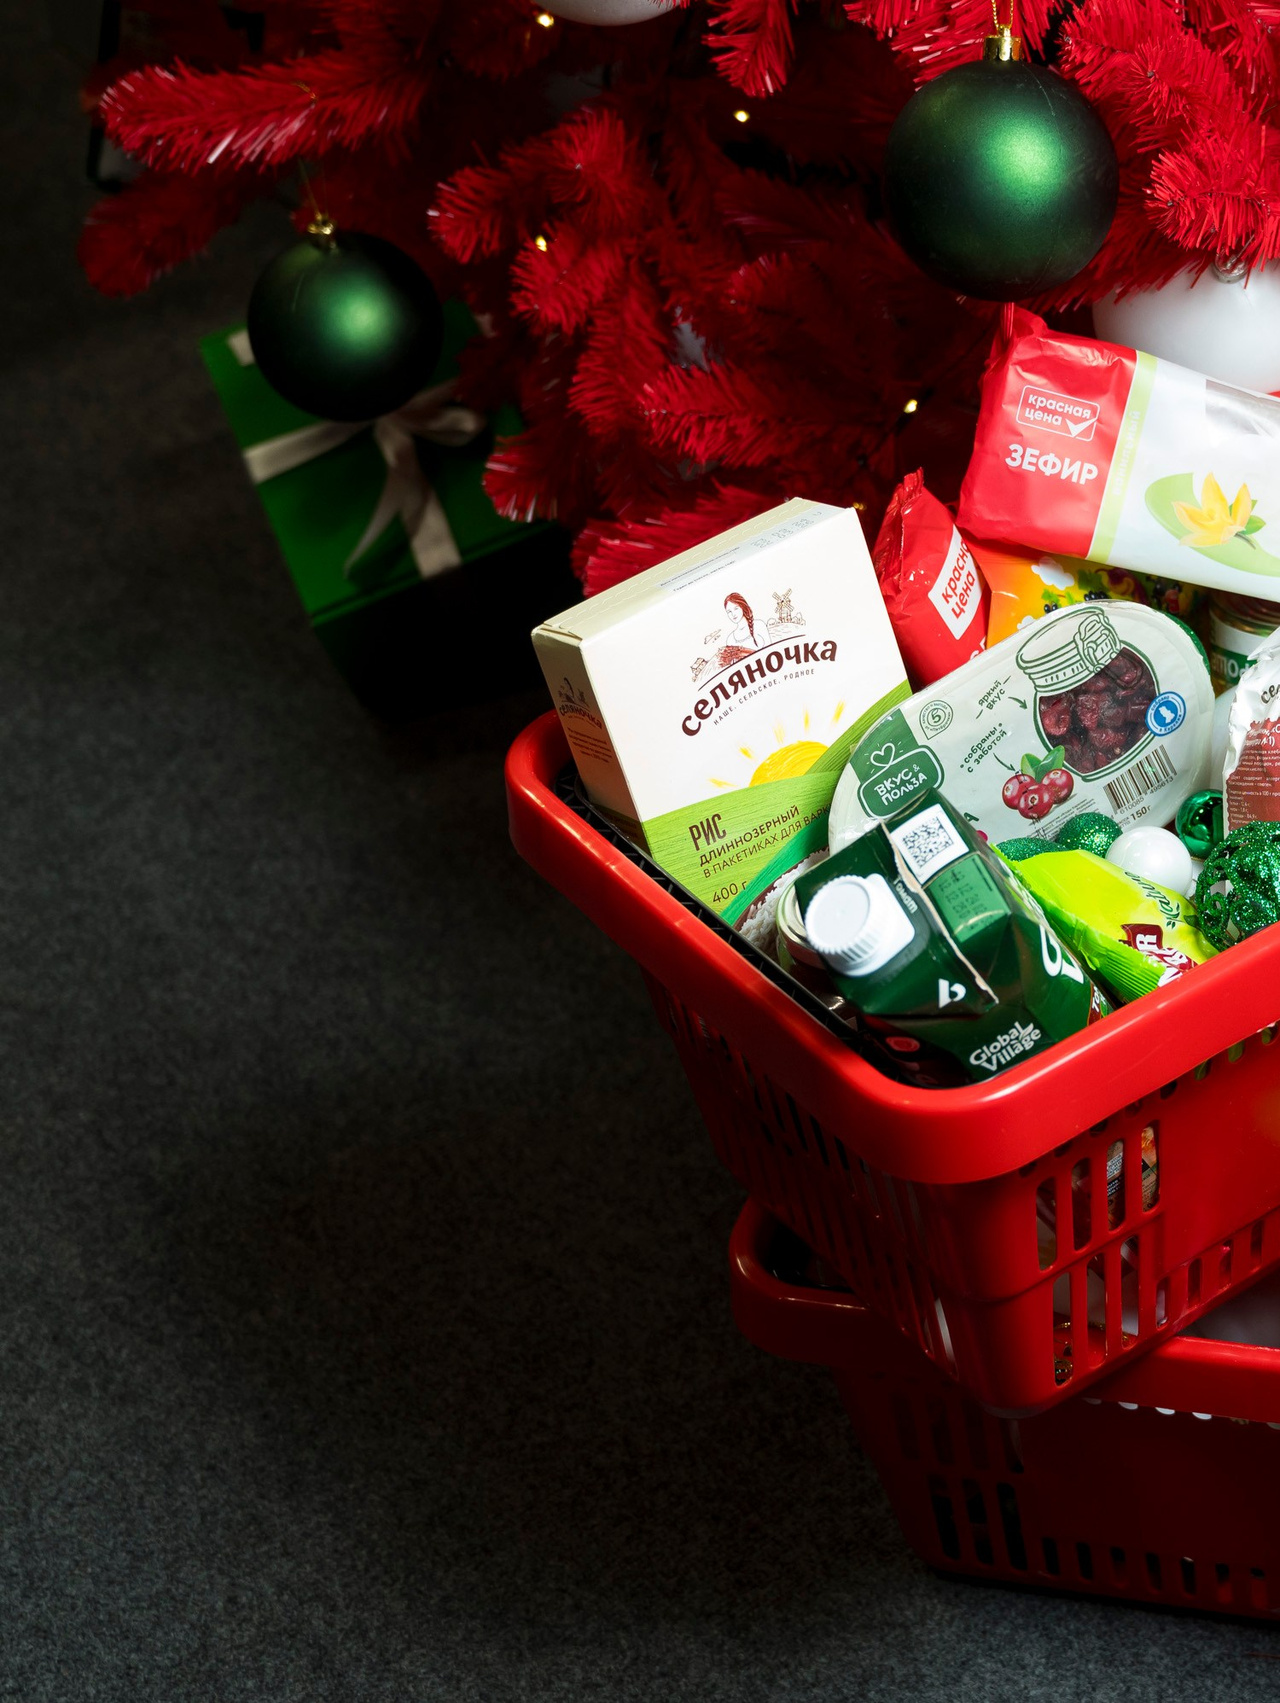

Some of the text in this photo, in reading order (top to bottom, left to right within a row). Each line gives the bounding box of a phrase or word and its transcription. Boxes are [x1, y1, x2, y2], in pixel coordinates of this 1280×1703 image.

[1025, 407, 1062, 426] цена
[1028, 394, 1091, 419] красная
[1005, 443, 1099, 485] ЗЕФИР
[951, 570, 976, 620] цена
[681, 640, 838, 737] селяночка
[713, 668, 815, 726] НАШЕ, СЕЛЬСКОЕ, РОДНОЕ
[978, 679, 1002, 707] яркий
[986, 688, 1006, 710] вкус
[963, 726, 998, 764] собраны
[973, 729, 1007, 765] заботой
[873, 763, 921, 796] ВКУС &
[881, 772, 928, 806] ПОЛЬЗА
[688, 813, 727, 852] РИС
[700, 805, 800, 867] ДЛИННОЗЕРНЫЙ
[703, 803, 831, 878] В ПАКЕТИКАХ ДЛЯ ВАРК
[712, 881, 748, 903] 400 г
[969, 1021, 1031, 1066] Global
